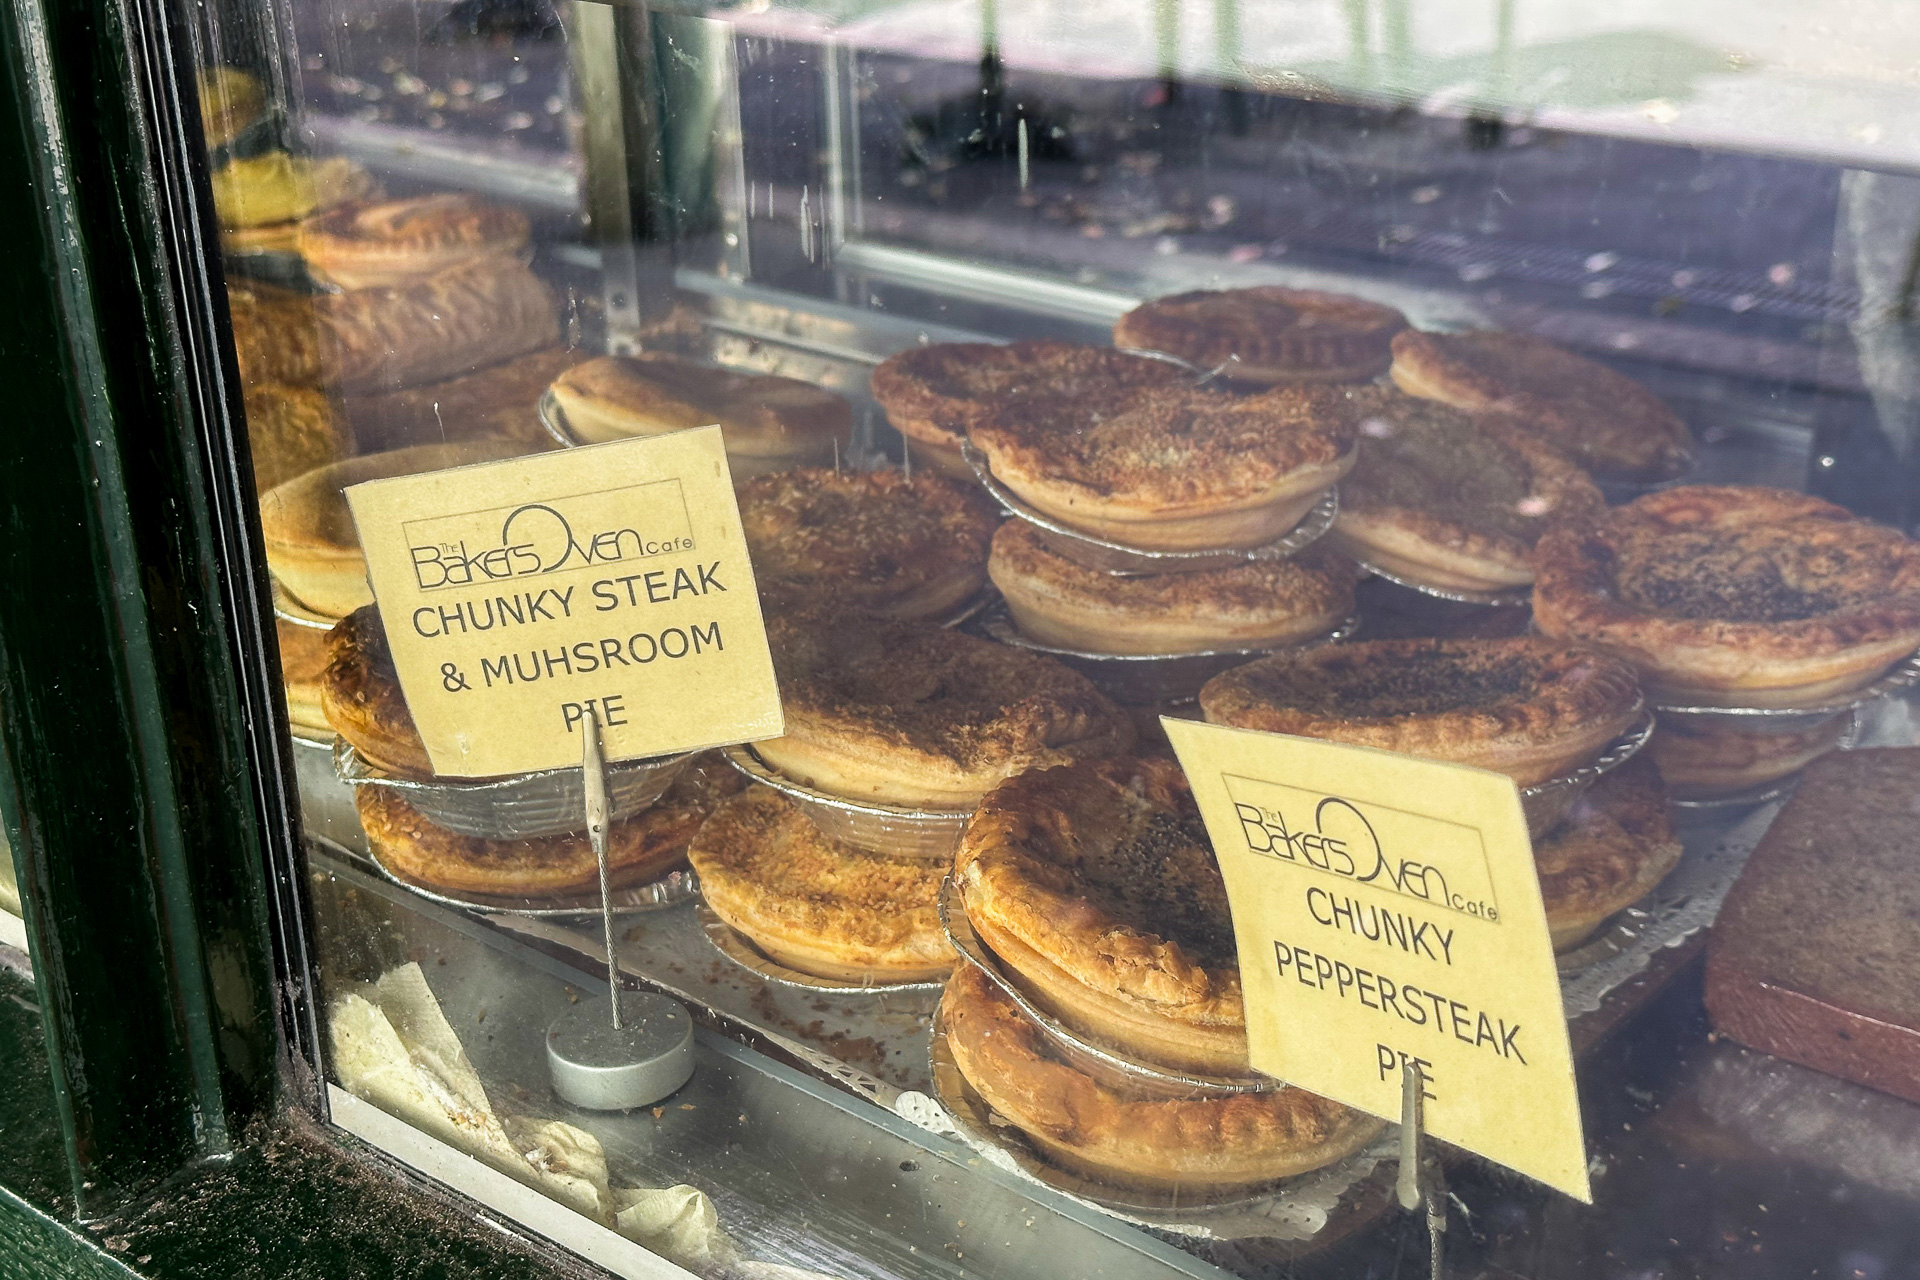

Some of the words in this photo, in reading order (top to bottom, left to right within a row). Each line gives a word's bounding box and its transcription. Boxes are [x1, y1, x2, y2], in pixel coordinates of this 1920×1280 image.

[412, 586, 575, 638] CHUNKY
[591, 561, 728, 612] STEAK
[441, 662, 472, 693] &
[481, 621, 725, 688] MUHSROOM
[1306, 887, 1454, 966] CHUNKY
[1273, 940, 1528, 1065] PEPPERSTEAK
